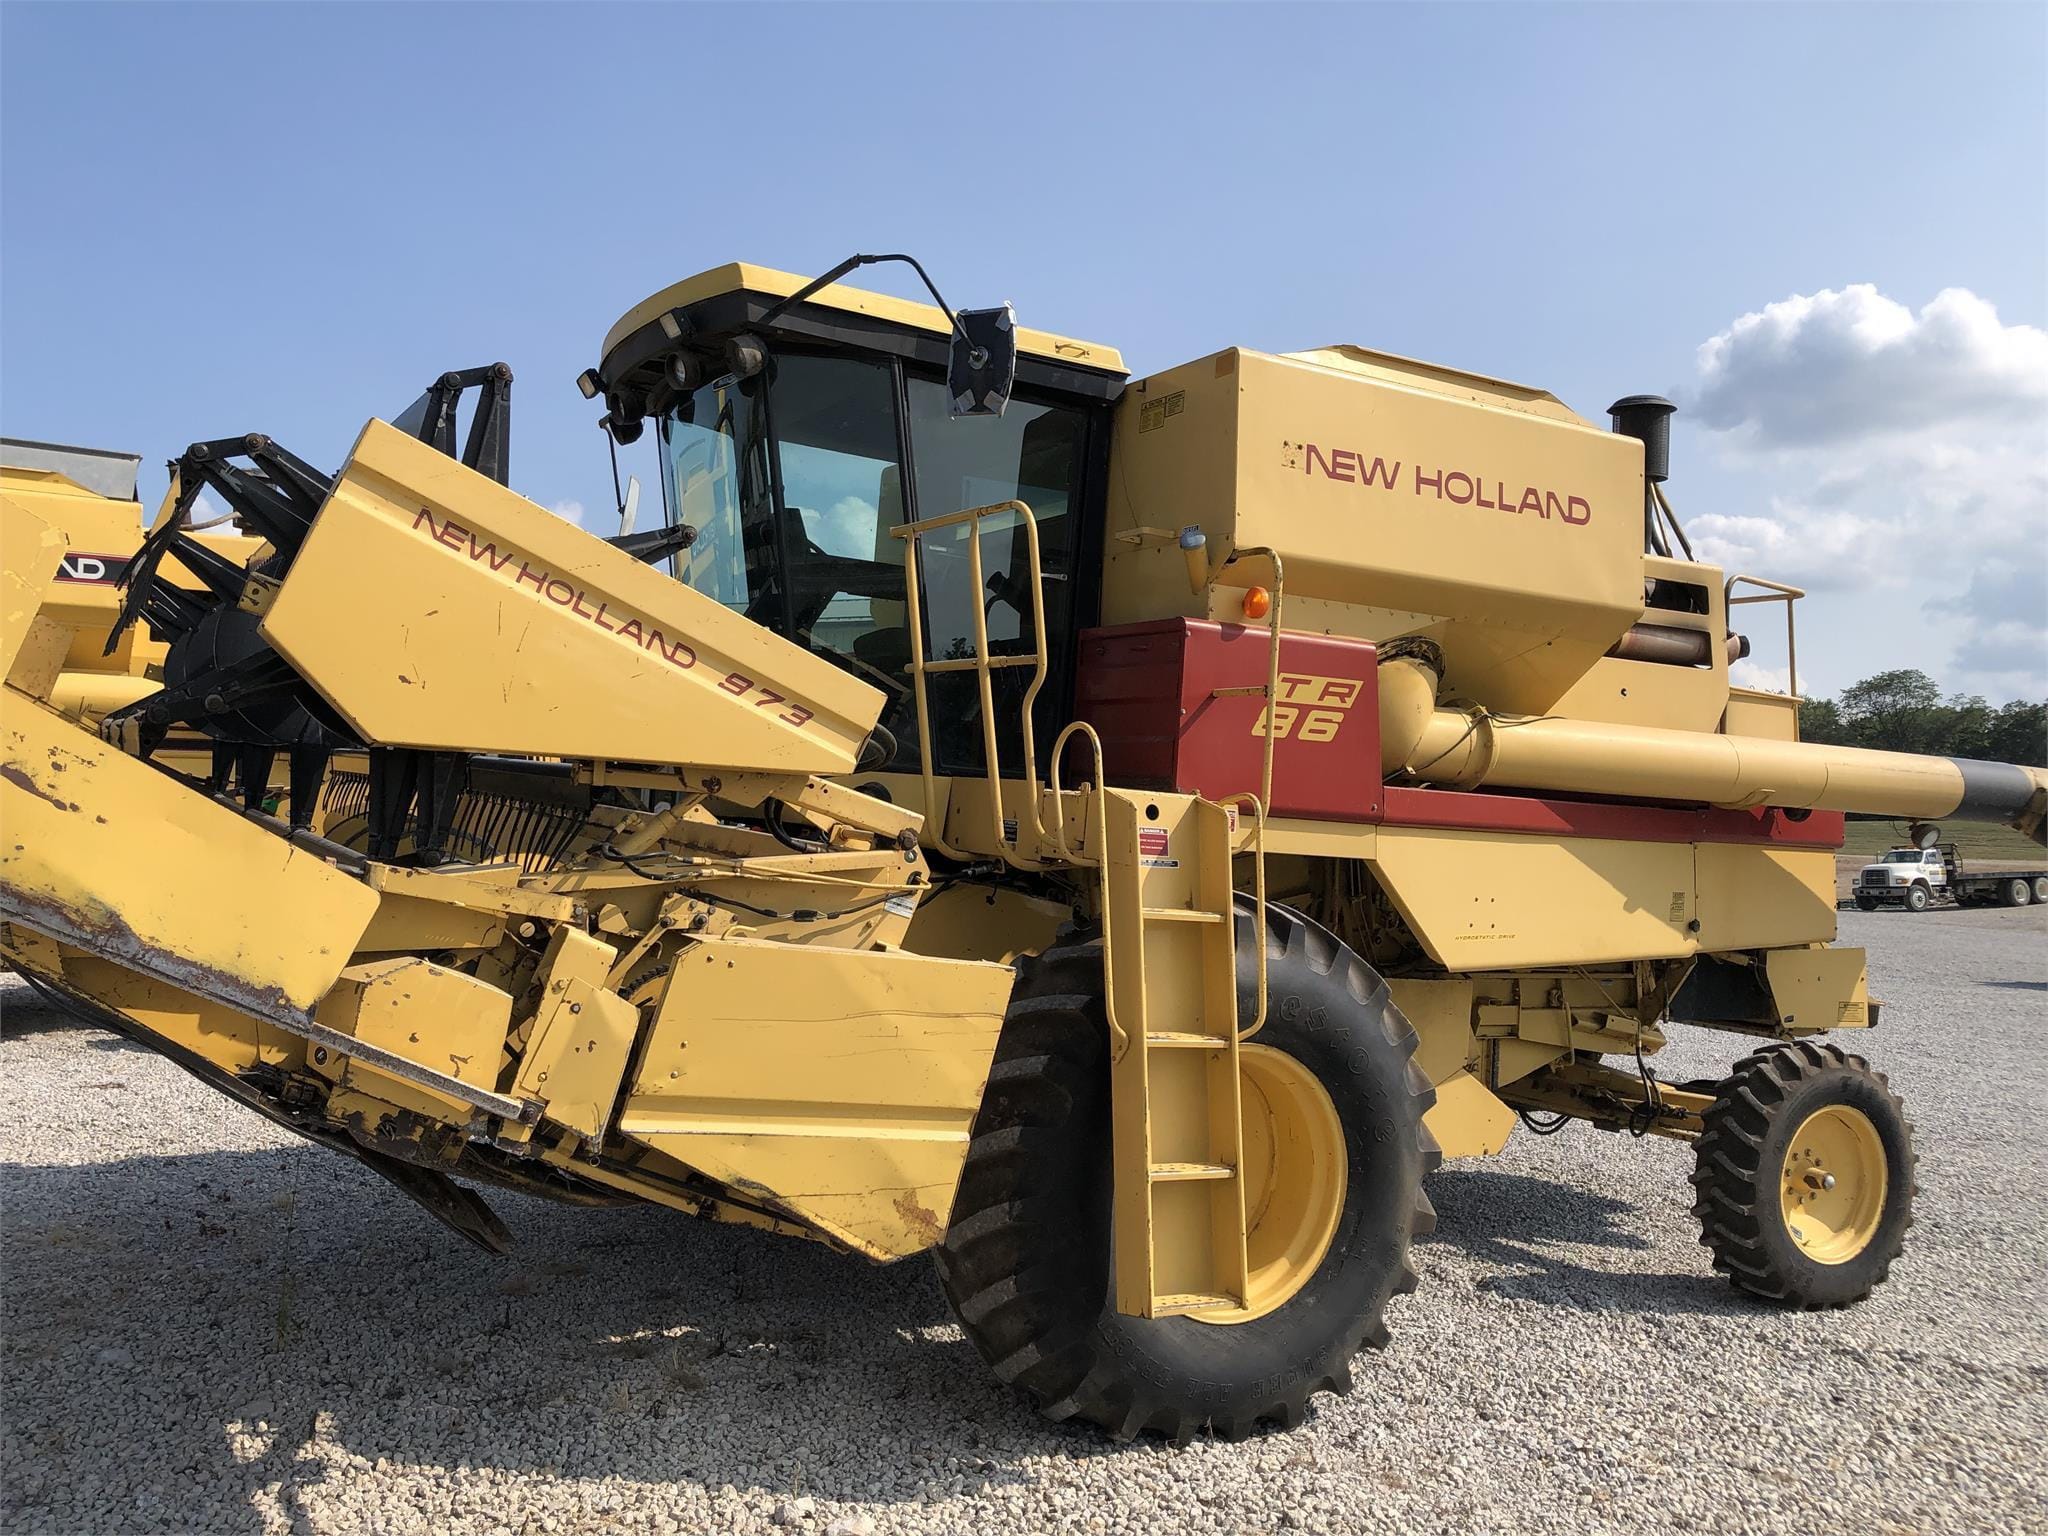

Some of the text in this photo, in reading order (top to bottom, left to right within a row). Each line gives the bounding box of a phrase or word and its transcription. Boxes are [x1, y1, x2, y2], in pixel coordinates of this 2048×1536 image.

[1305, 443, 1591, 526] NEW HOLLAND
[411, 507, 814, 728] NEW HOLLAND 973
[1280, 676, 1356, 703] TR
[1251, 705, 1344, 742] 86
